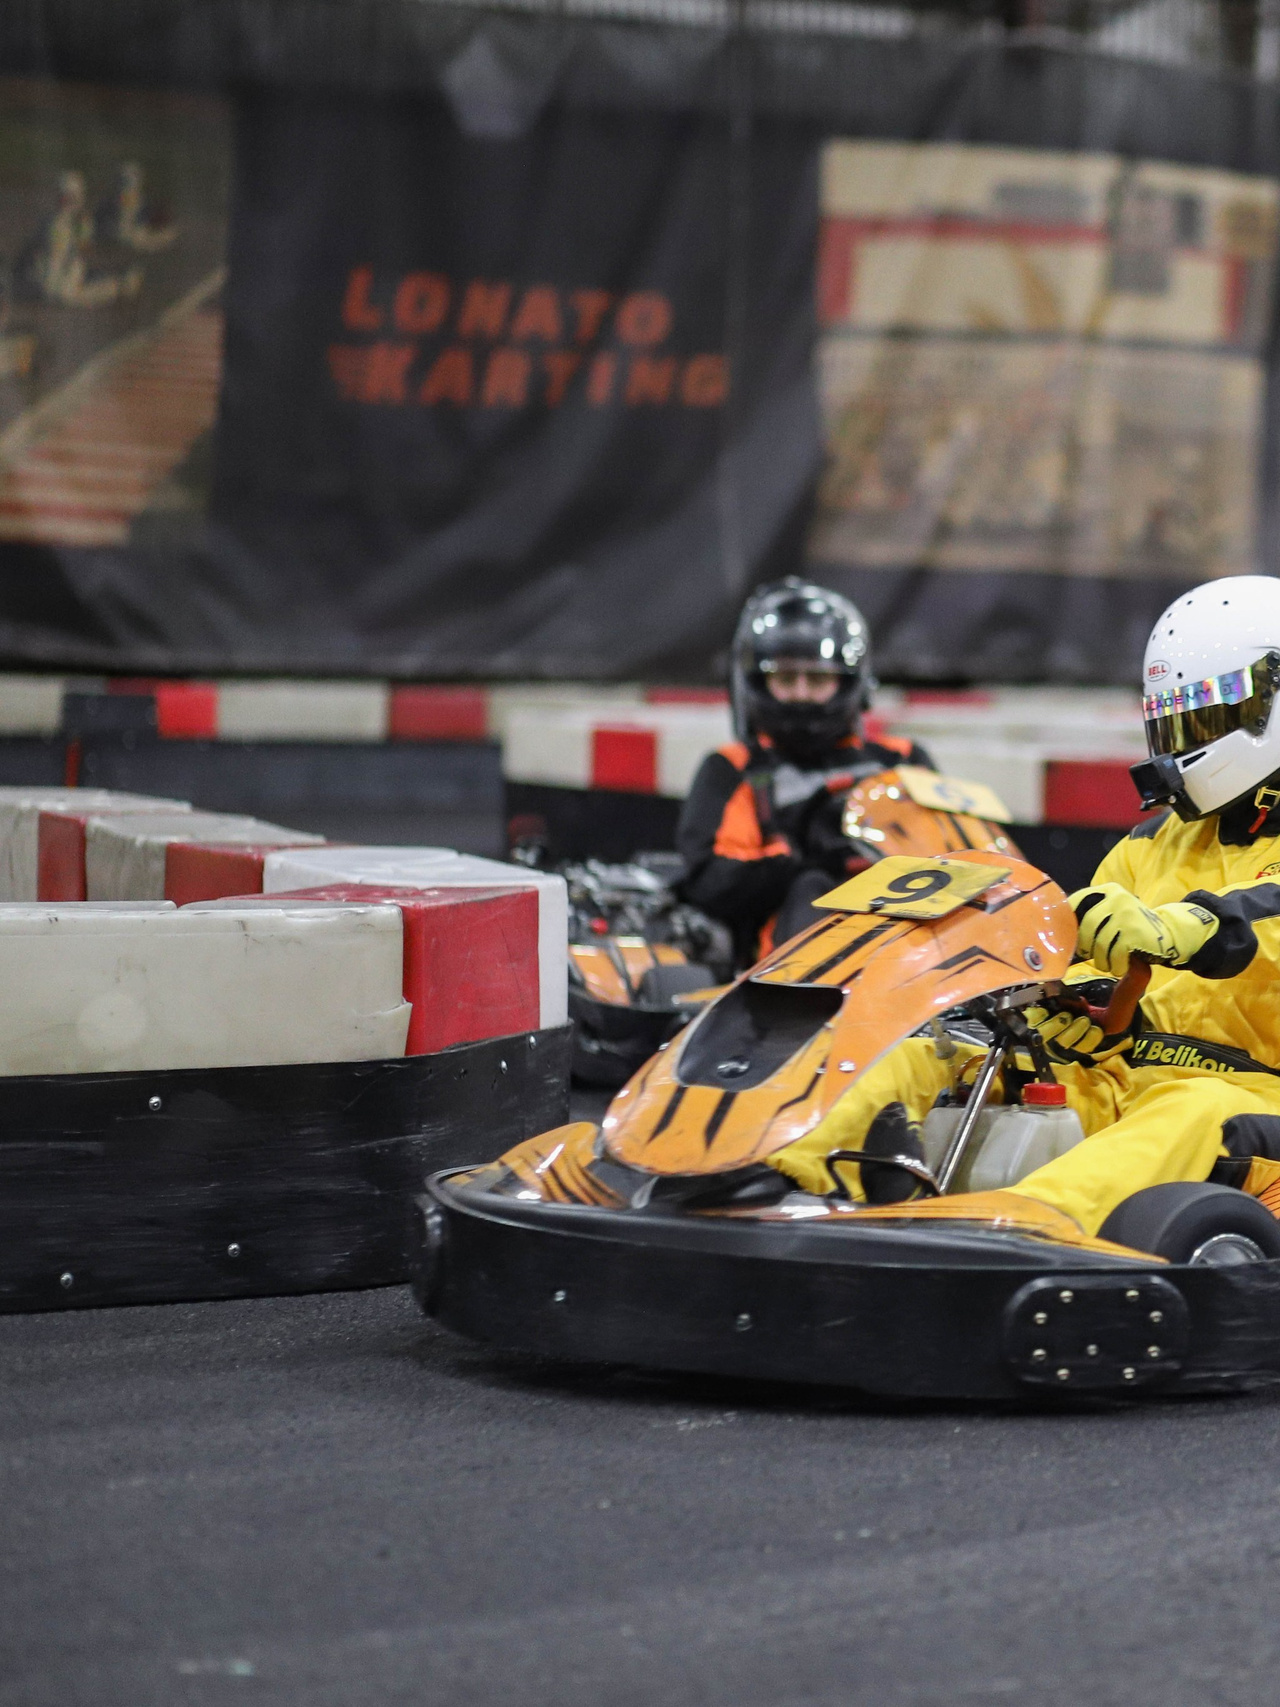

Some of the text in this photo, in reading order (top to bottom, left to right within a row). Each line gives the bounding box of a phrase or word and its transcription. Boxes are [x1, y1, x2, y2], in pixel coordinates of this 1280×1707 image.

[343, 264, 673, 344] LONATO
[352, 342, 731, 406] KARTING
[1148, 664, 1167, 677] BELL
[872, 869, 951, 904] 9
